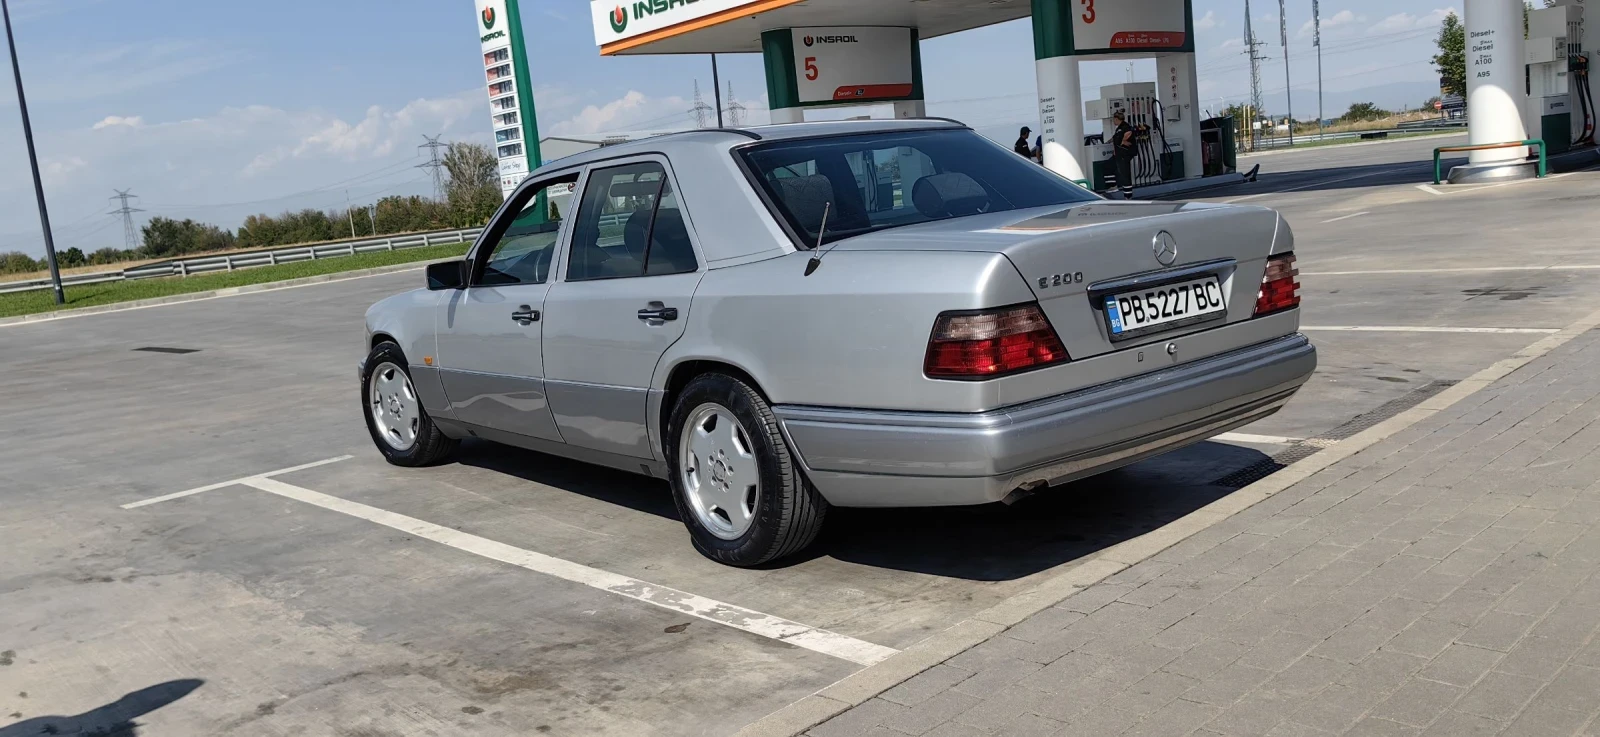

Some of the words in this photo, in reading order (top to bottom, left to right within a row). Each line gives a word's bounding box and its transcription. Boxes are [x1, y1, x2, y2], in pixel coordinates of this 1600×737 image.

[1081, 0, 1096, 24] 3
[816, 35, 858, 44] INSAOIL
[1470, 29, 1495, 38] Diesel+
[1472, 44, 1493, 52] Diesel
[804, 56, 819, 81] 5
[1037, 276, 1048, 289] E
[1051, 271, 1083, 287] 200
[1118, 295, 1146, 326] PB
[1145, 285, 1189, 321] 5227
[1192, 281, 1220, 310] BC
[1111, 318, 1121, 328] BG
